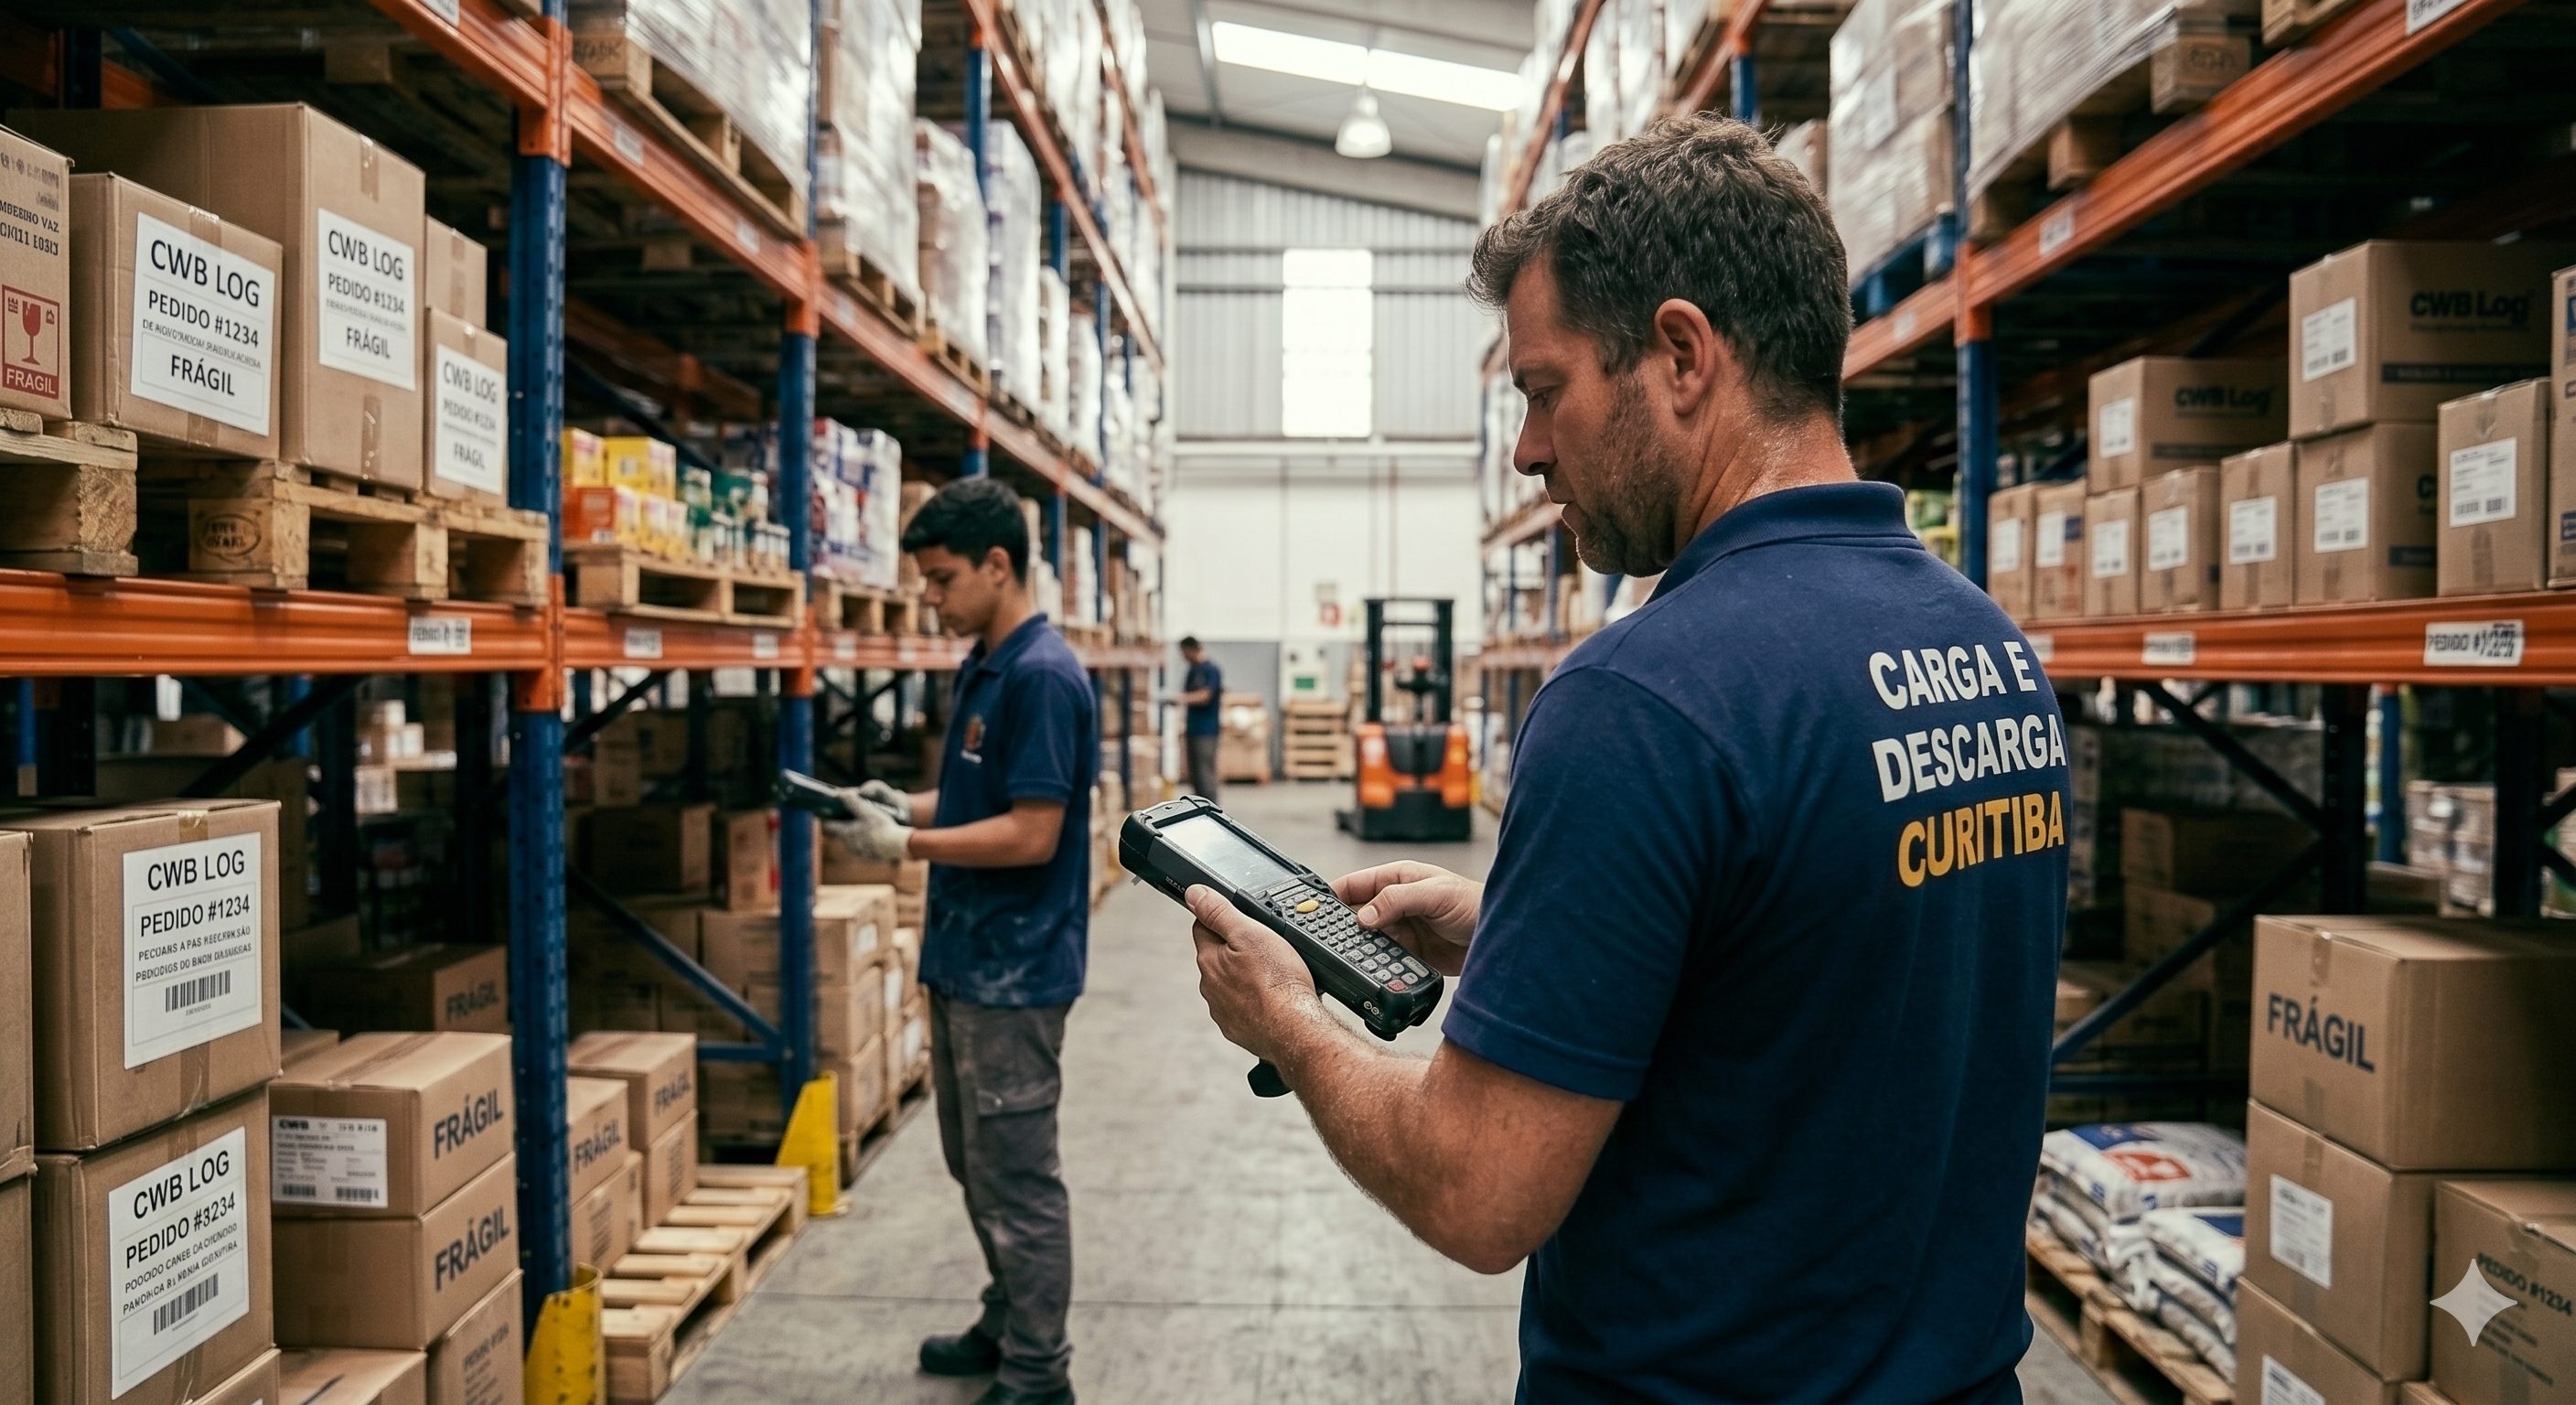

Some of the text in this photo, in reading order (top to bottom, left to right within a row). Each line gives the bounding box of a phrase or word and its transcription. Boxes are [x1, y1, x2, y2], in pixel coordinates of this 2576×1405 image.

[151, 240, 260, 307] CWB LOG
[328, 230, 403, 282] CWB LOG
[149, 290, 210, 329] PEDIDO
[215, 315, 259, 347] #1234
[328, 273, 404, 315] PEDIDO #1234
[2410, 291, 2473, 317] CWB
[347, 327, 391, 359] FRÁGIL
[6, 368, 56, 394] FRAGIL
[171, 355, 235, 396] FRÁGIL
[444, 361, 497, 404] CWB LOG
[1869, 641, 2037, 711] CARGA E
[1872, 713, 2066, 803] DESCARGA
[1898, 790, 2065, 887] CURITIBA
[147, 850, 244, 891] CWB LOG
[141, 894, 250, 938] PEDIDO #1234
[2268, 992, 2376, 1074] FRÁGIL
[435, 1089, 504, 1160] FRÁGIL
[574, 1119, 621, 1175] FRÁGIL
[134, 1174, 183, 1220] CWB
[189, 1150, 230, 1193] LOG
[126, 1217, 189, 1269] PEDIDO
[435, 1206, 510, 1292] FRÁGIL
